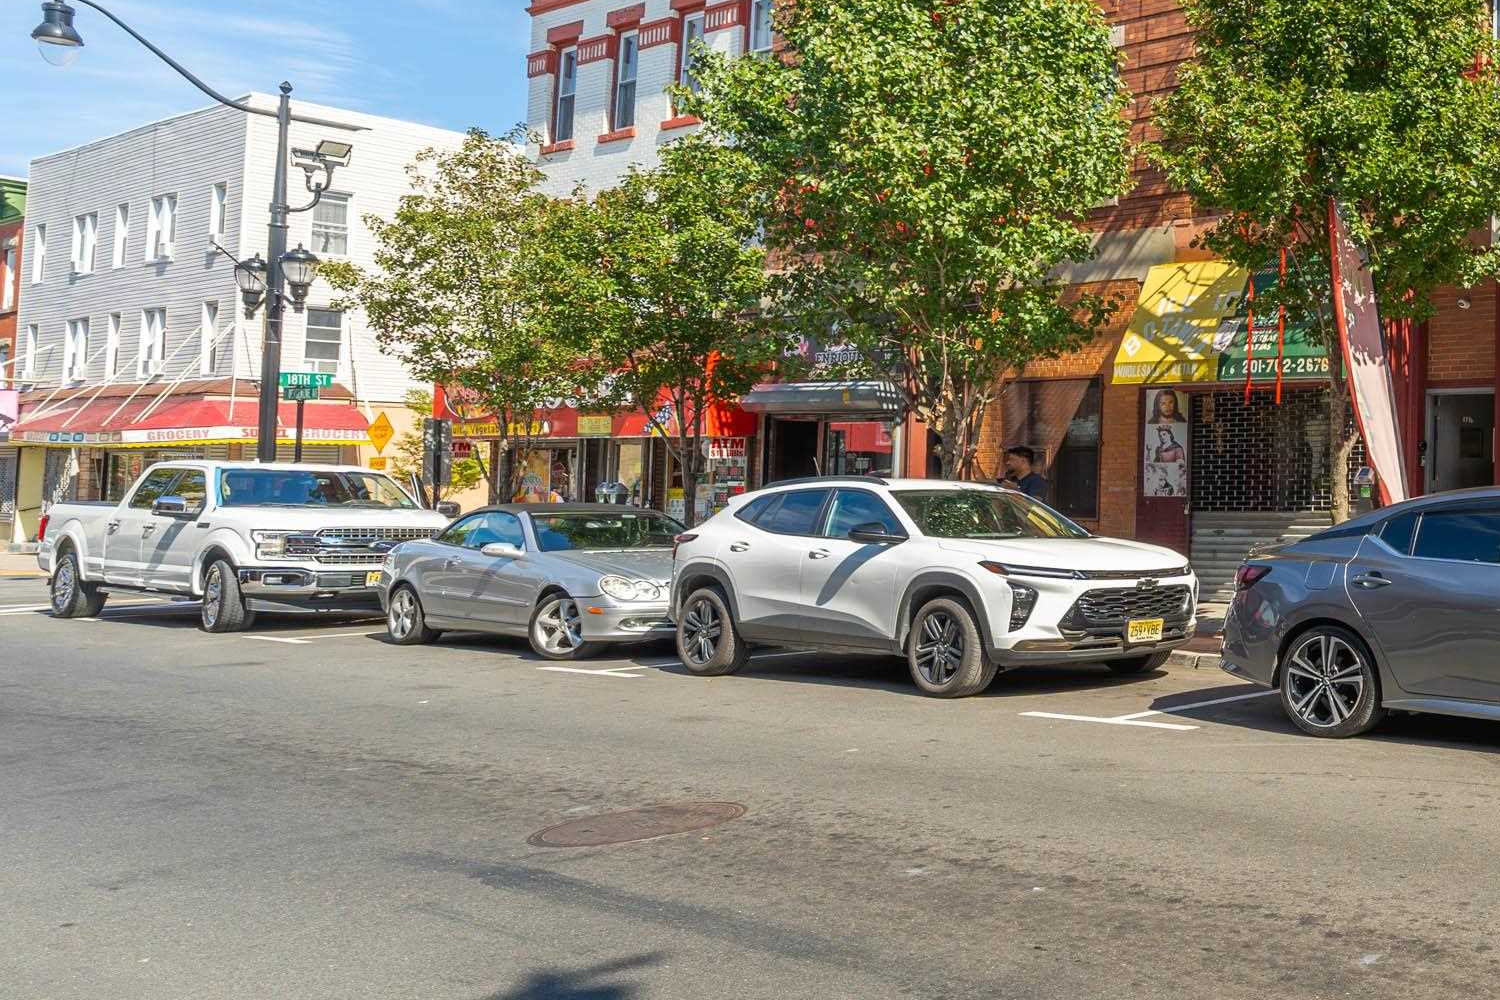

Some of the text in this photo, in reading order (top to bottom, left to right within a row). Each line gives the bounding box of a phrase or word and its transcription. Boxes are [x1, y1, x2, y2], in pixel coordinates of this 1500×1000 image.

[287, 374, 328, 386] 18TH ST
[147, 429, 211, 441] GROCERY
[303, 429, 368, 440] GROCERY
